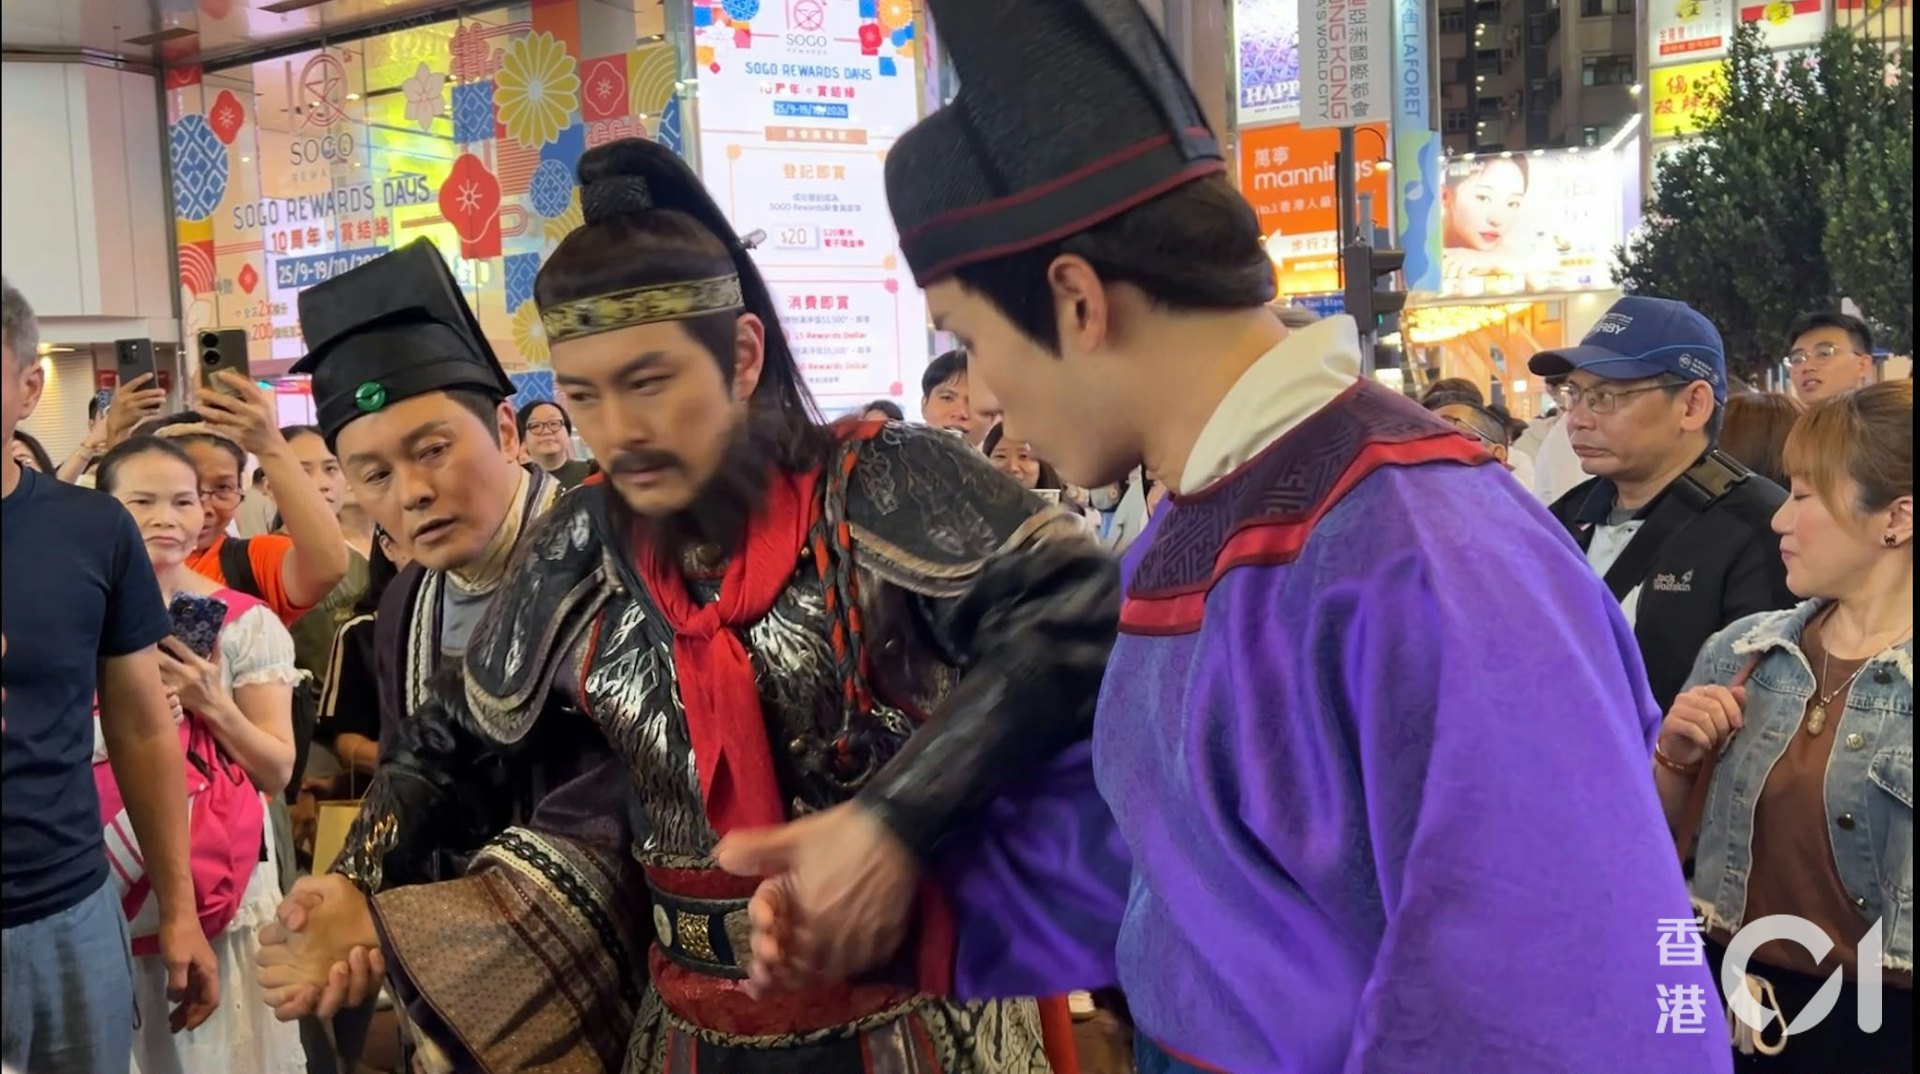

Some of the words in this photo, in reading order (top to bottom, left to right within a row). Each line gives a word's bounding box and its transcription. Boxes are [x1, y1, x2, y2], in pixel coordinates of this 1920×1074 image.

[786, 33, 828, 48] SOGO
[1316, 24, 1329, 82] WORLD
[744, 61, 779, 76] SOGO
[782, 63, 841, 79] REWARDS
[843, 67, 873, 80] DAYS
[1348, 9, 1370, 118] 亞洲國際都會
[1403, 34, 1421, 118] LAFORET
[1329, 46, 1349, 120] KONG
[1317, 84, 1330, 120] CITY
[290, 131, 354, 167] SOGO
[1254, 146, 1290, 168] 萬寧
[233, 201, 280, 230] SOGO
[286, 185, 375, 223] REWARDS
[383, 176, 431, 208] DAYS
[780, 227, 808, 246] $20
[277, 251, 386, 286] 25/9-19/10/2
[787, 294, 850, 310] 消費即賞
[1323, 298, 1345, 308] Stan
[806, 331, 842, 340] Rewards
